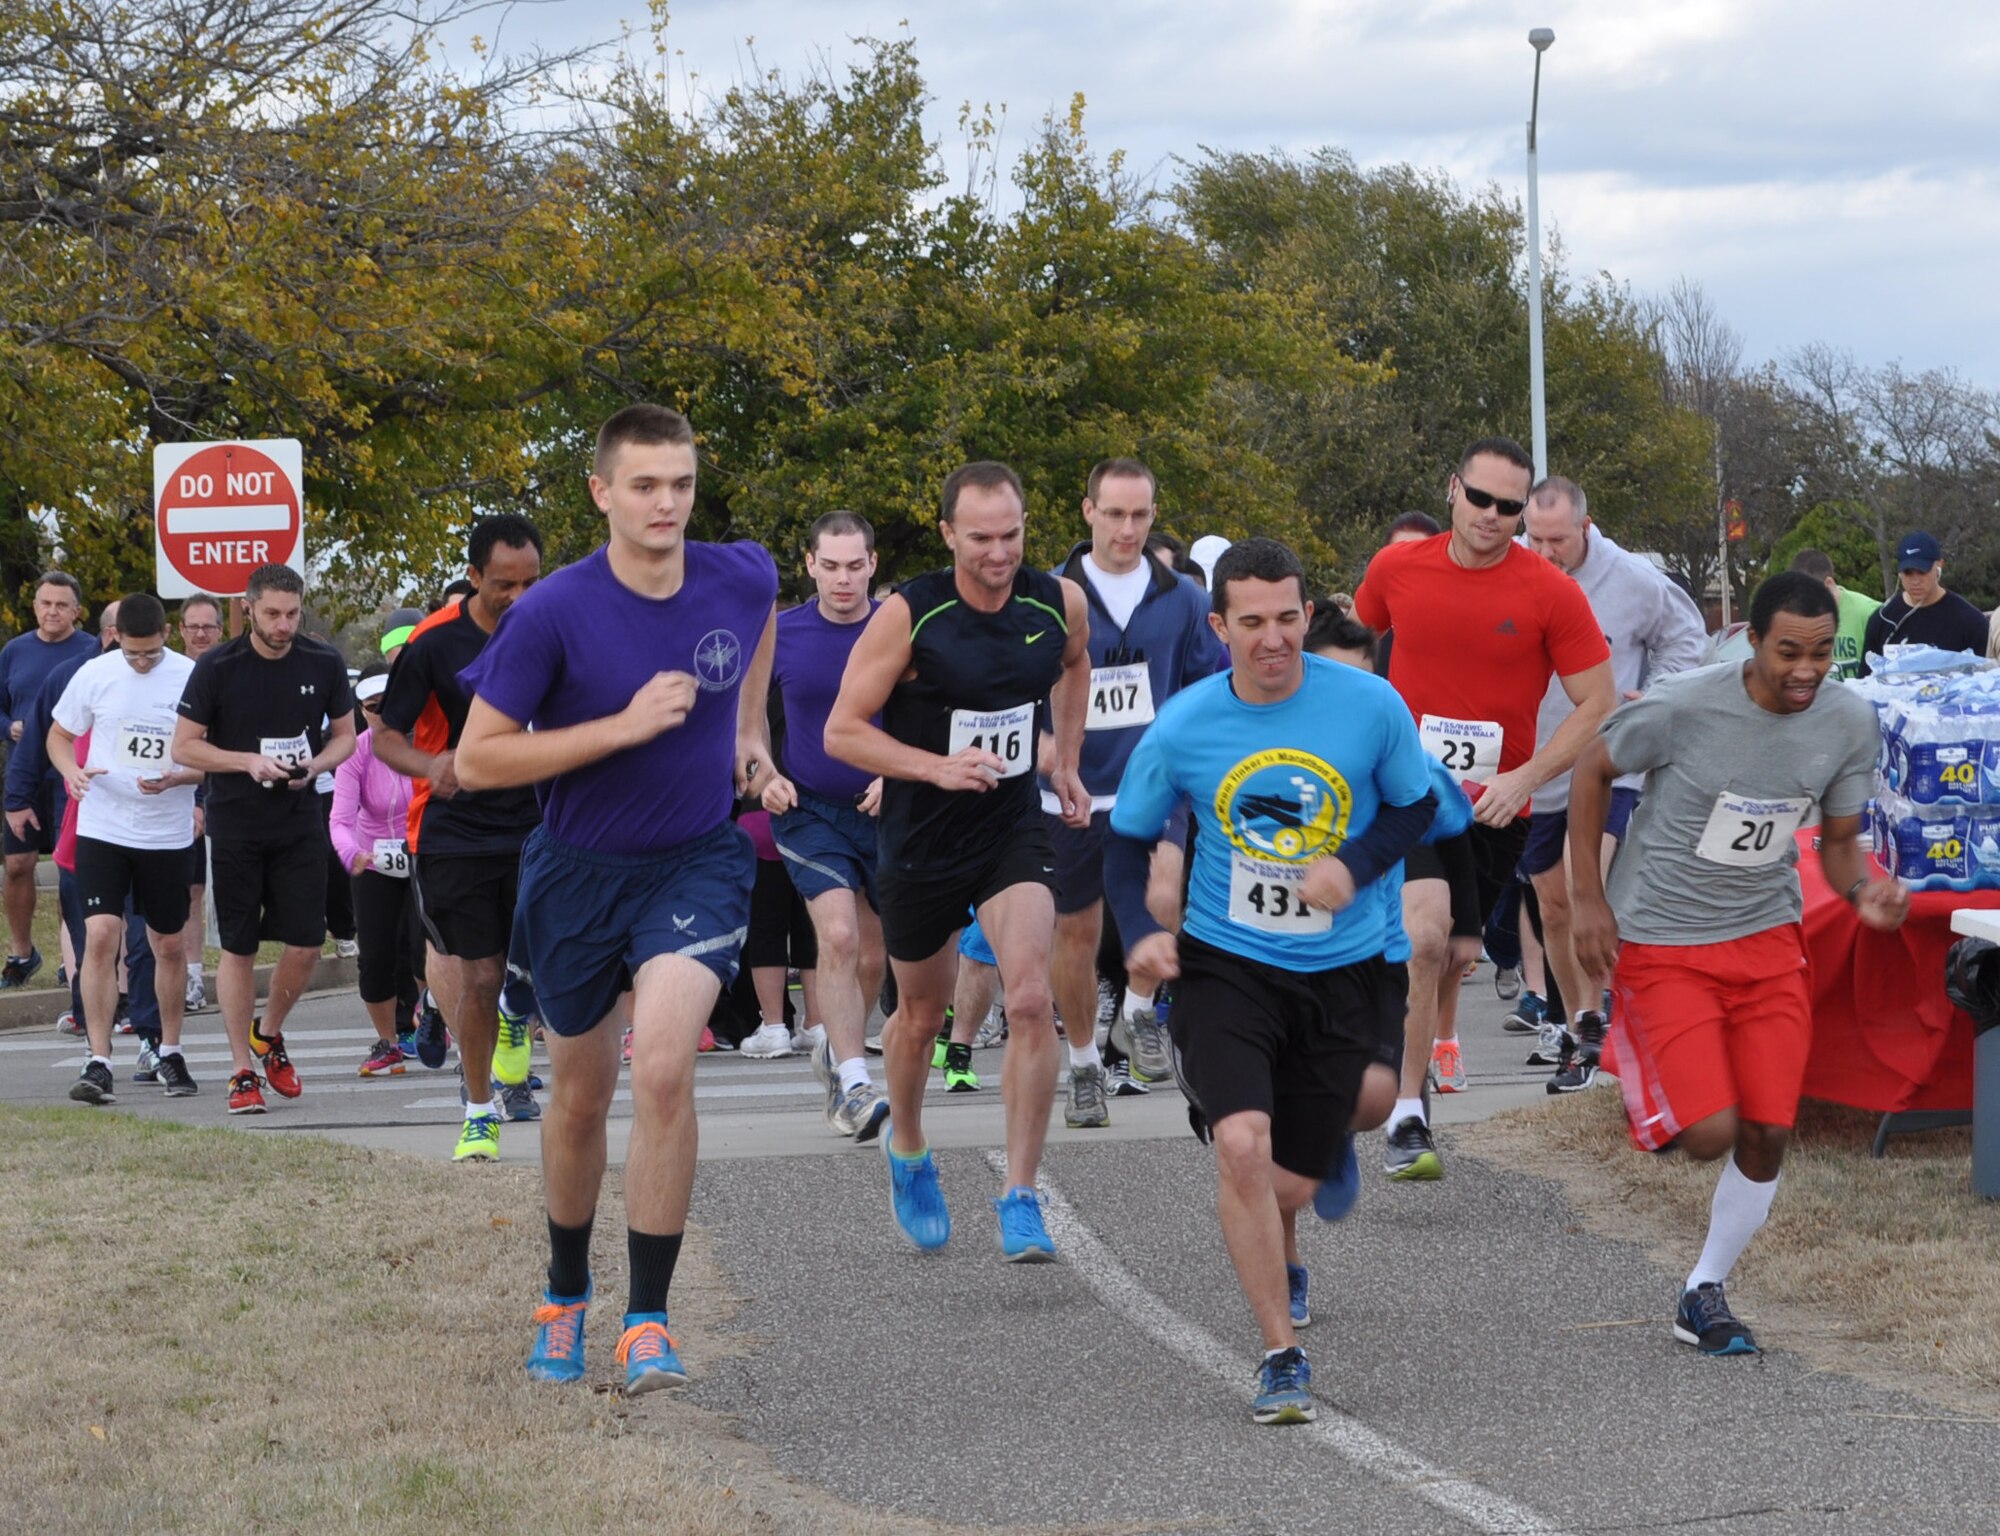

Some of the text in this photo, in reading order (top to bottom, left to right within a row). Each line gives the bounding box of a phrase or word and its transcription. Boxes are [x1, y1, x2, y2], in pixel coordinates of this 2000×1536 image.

[180, 471, 275, 498] DO NOT
[189, 540, 269, 565] ENTER
[1833, 636, 1857, 658] KS
[1094, 683, 1139, 714] 407
[1426, 725, 1442, 733] FUN
[1444, 728, 1461, 736] RUN
[128, 736, 165, 759] 423
[1441, 739, 1476, 771] 23
[1939, 762, 1975, 784] 40
[1731, 820, 1775, 851] 20
[1926, 838, 1961, 859] 40
[384, 853, 406, 870] 38
